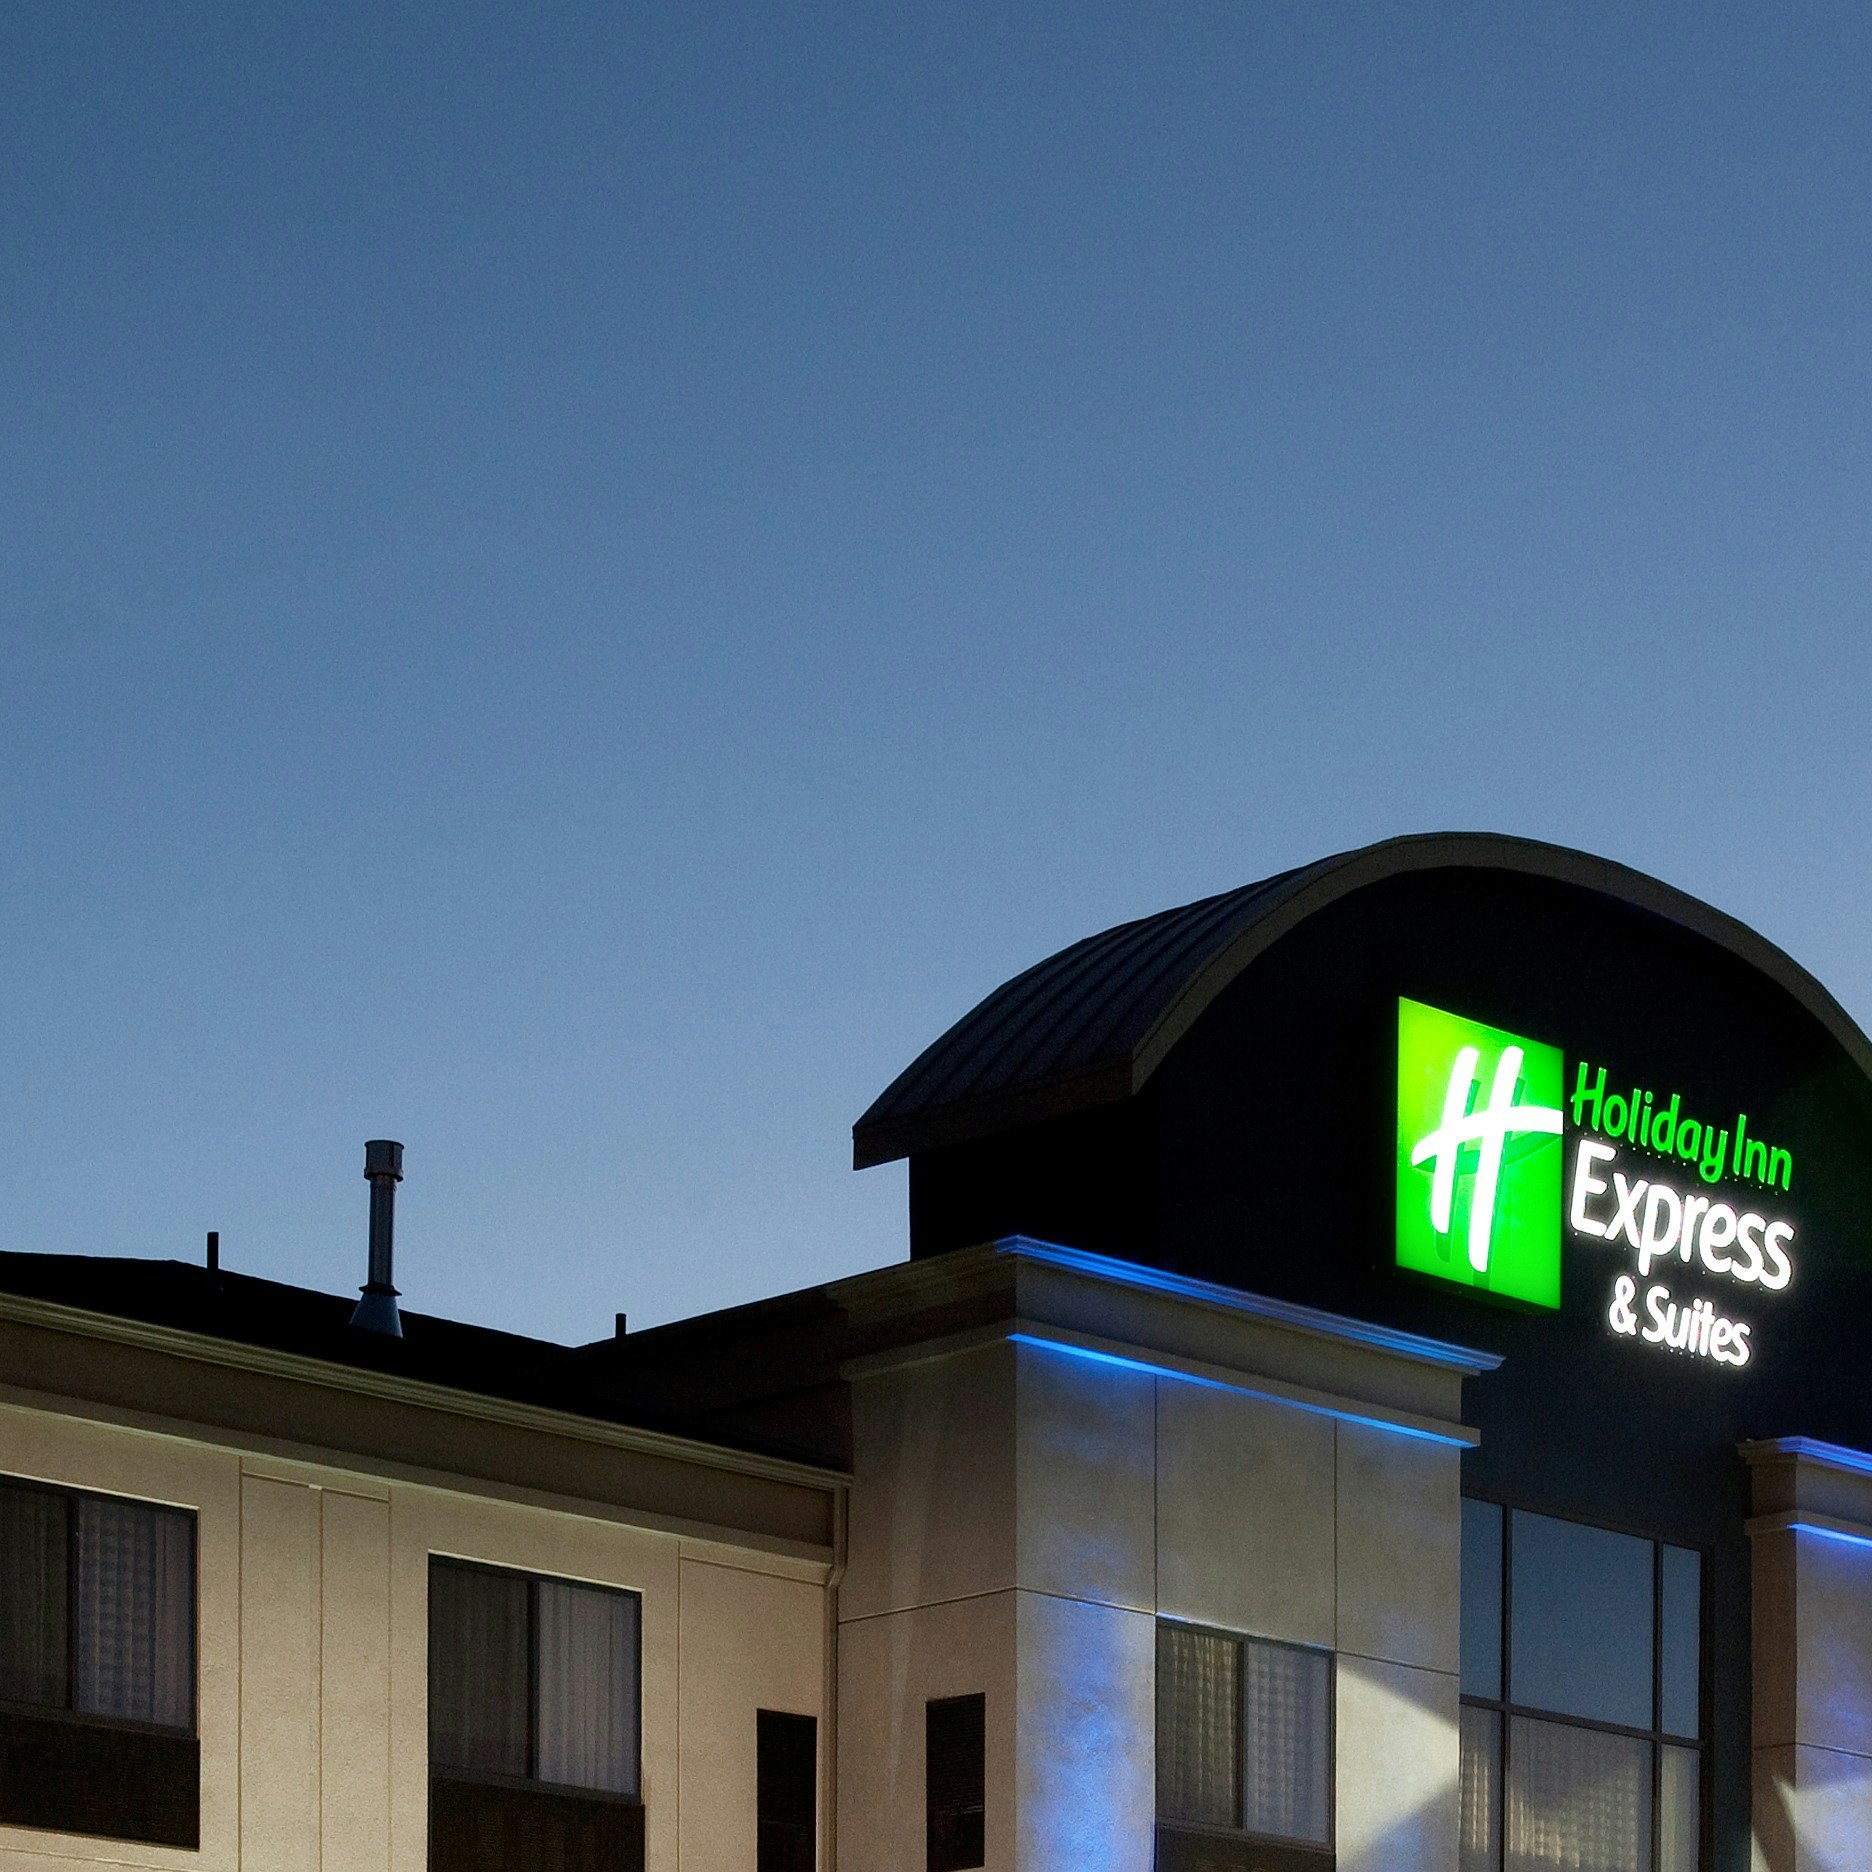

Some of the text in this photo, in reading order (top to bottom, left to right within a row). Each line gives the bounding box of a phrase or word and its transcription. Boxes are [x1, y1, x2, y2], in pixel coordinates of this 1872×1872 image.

[1570, 1061, 1794, 1191] Holiday Inn
[1570, 1139, 1796, 1291] Express
[1608, 1274, 1752, 1367] & Suites
